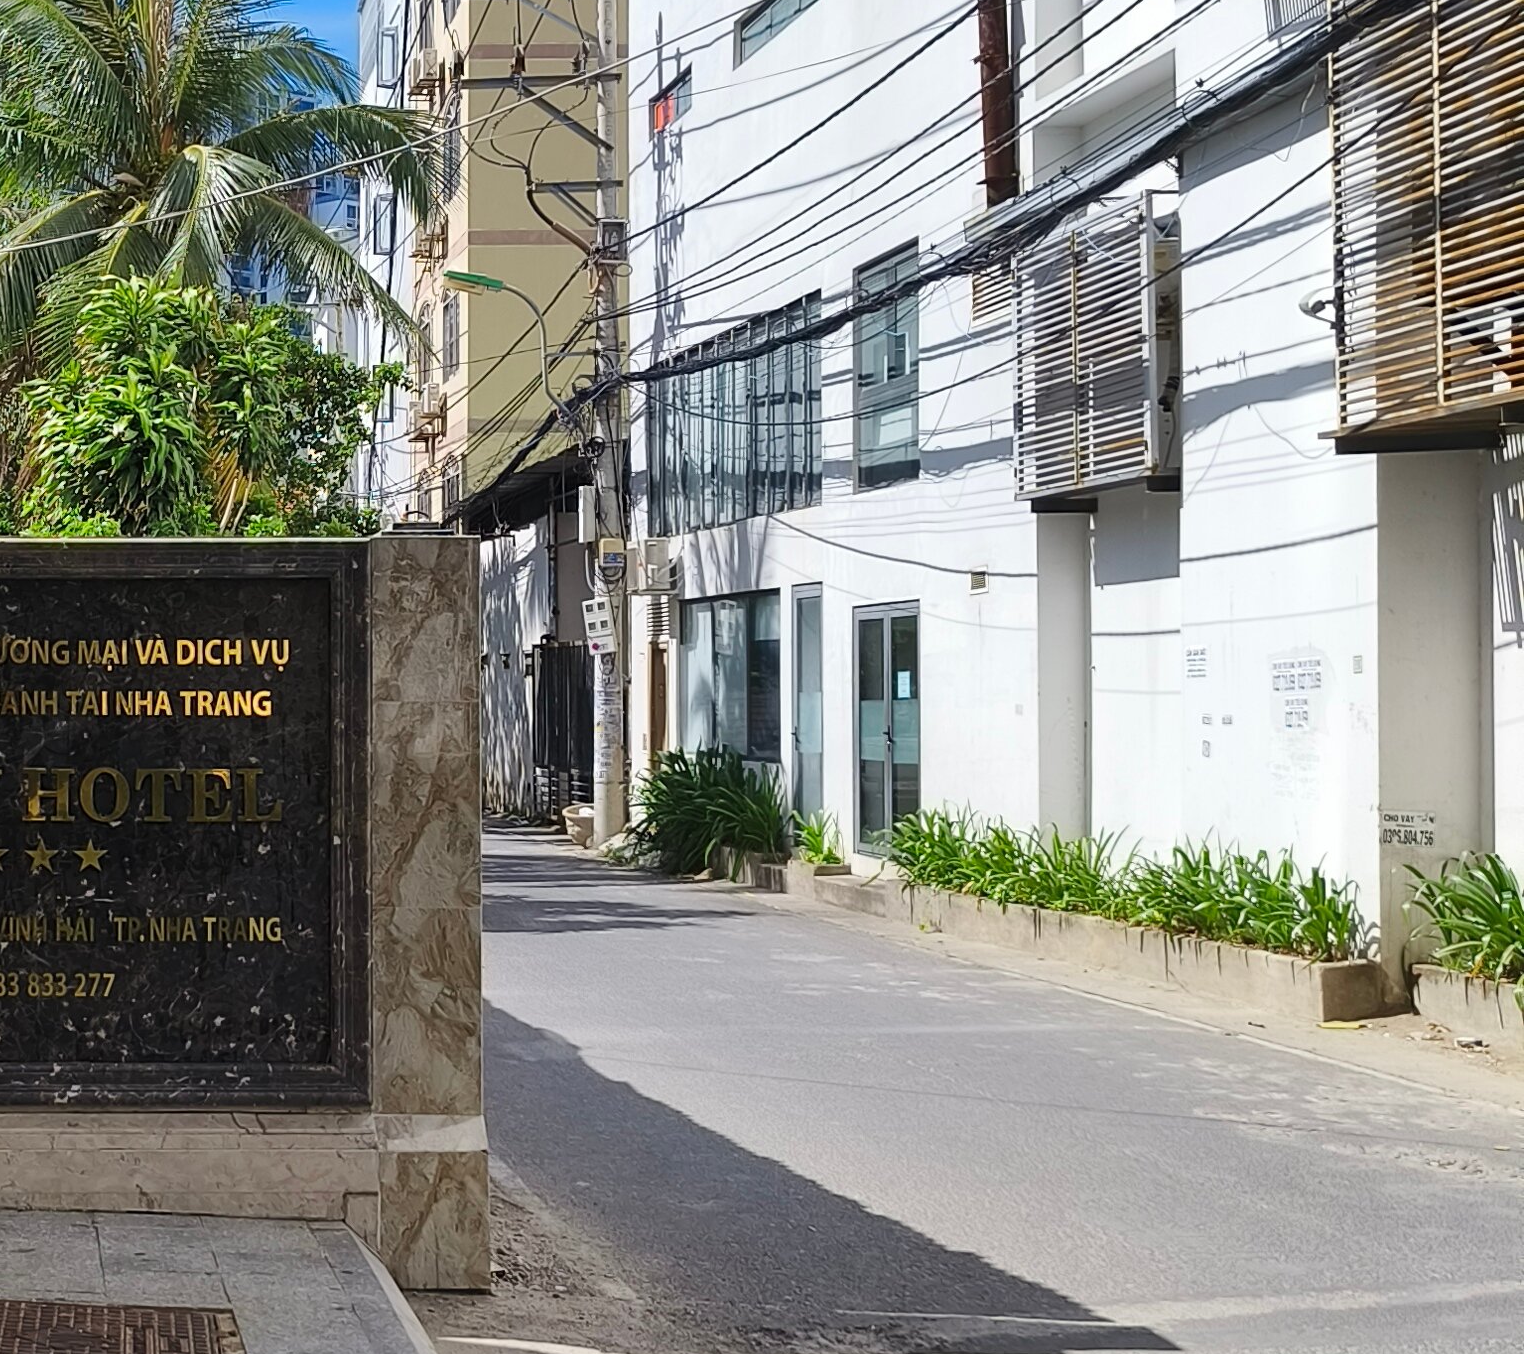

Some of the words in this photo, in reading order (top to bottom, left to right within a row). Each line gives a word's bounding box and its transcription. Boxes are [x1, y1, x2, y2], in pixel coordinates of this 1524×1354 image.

[77, 638, 127, 672] MẠI
[135, 633, 169, 665] VÀ
[251, 639, 290, 673] VỤ
[115, 690, 173, 717] NHA
[180, 690, 272, 717] TRANG
[22, 766, 283, 823] HOTEL
[203, 916, 282, 943] TRANG
